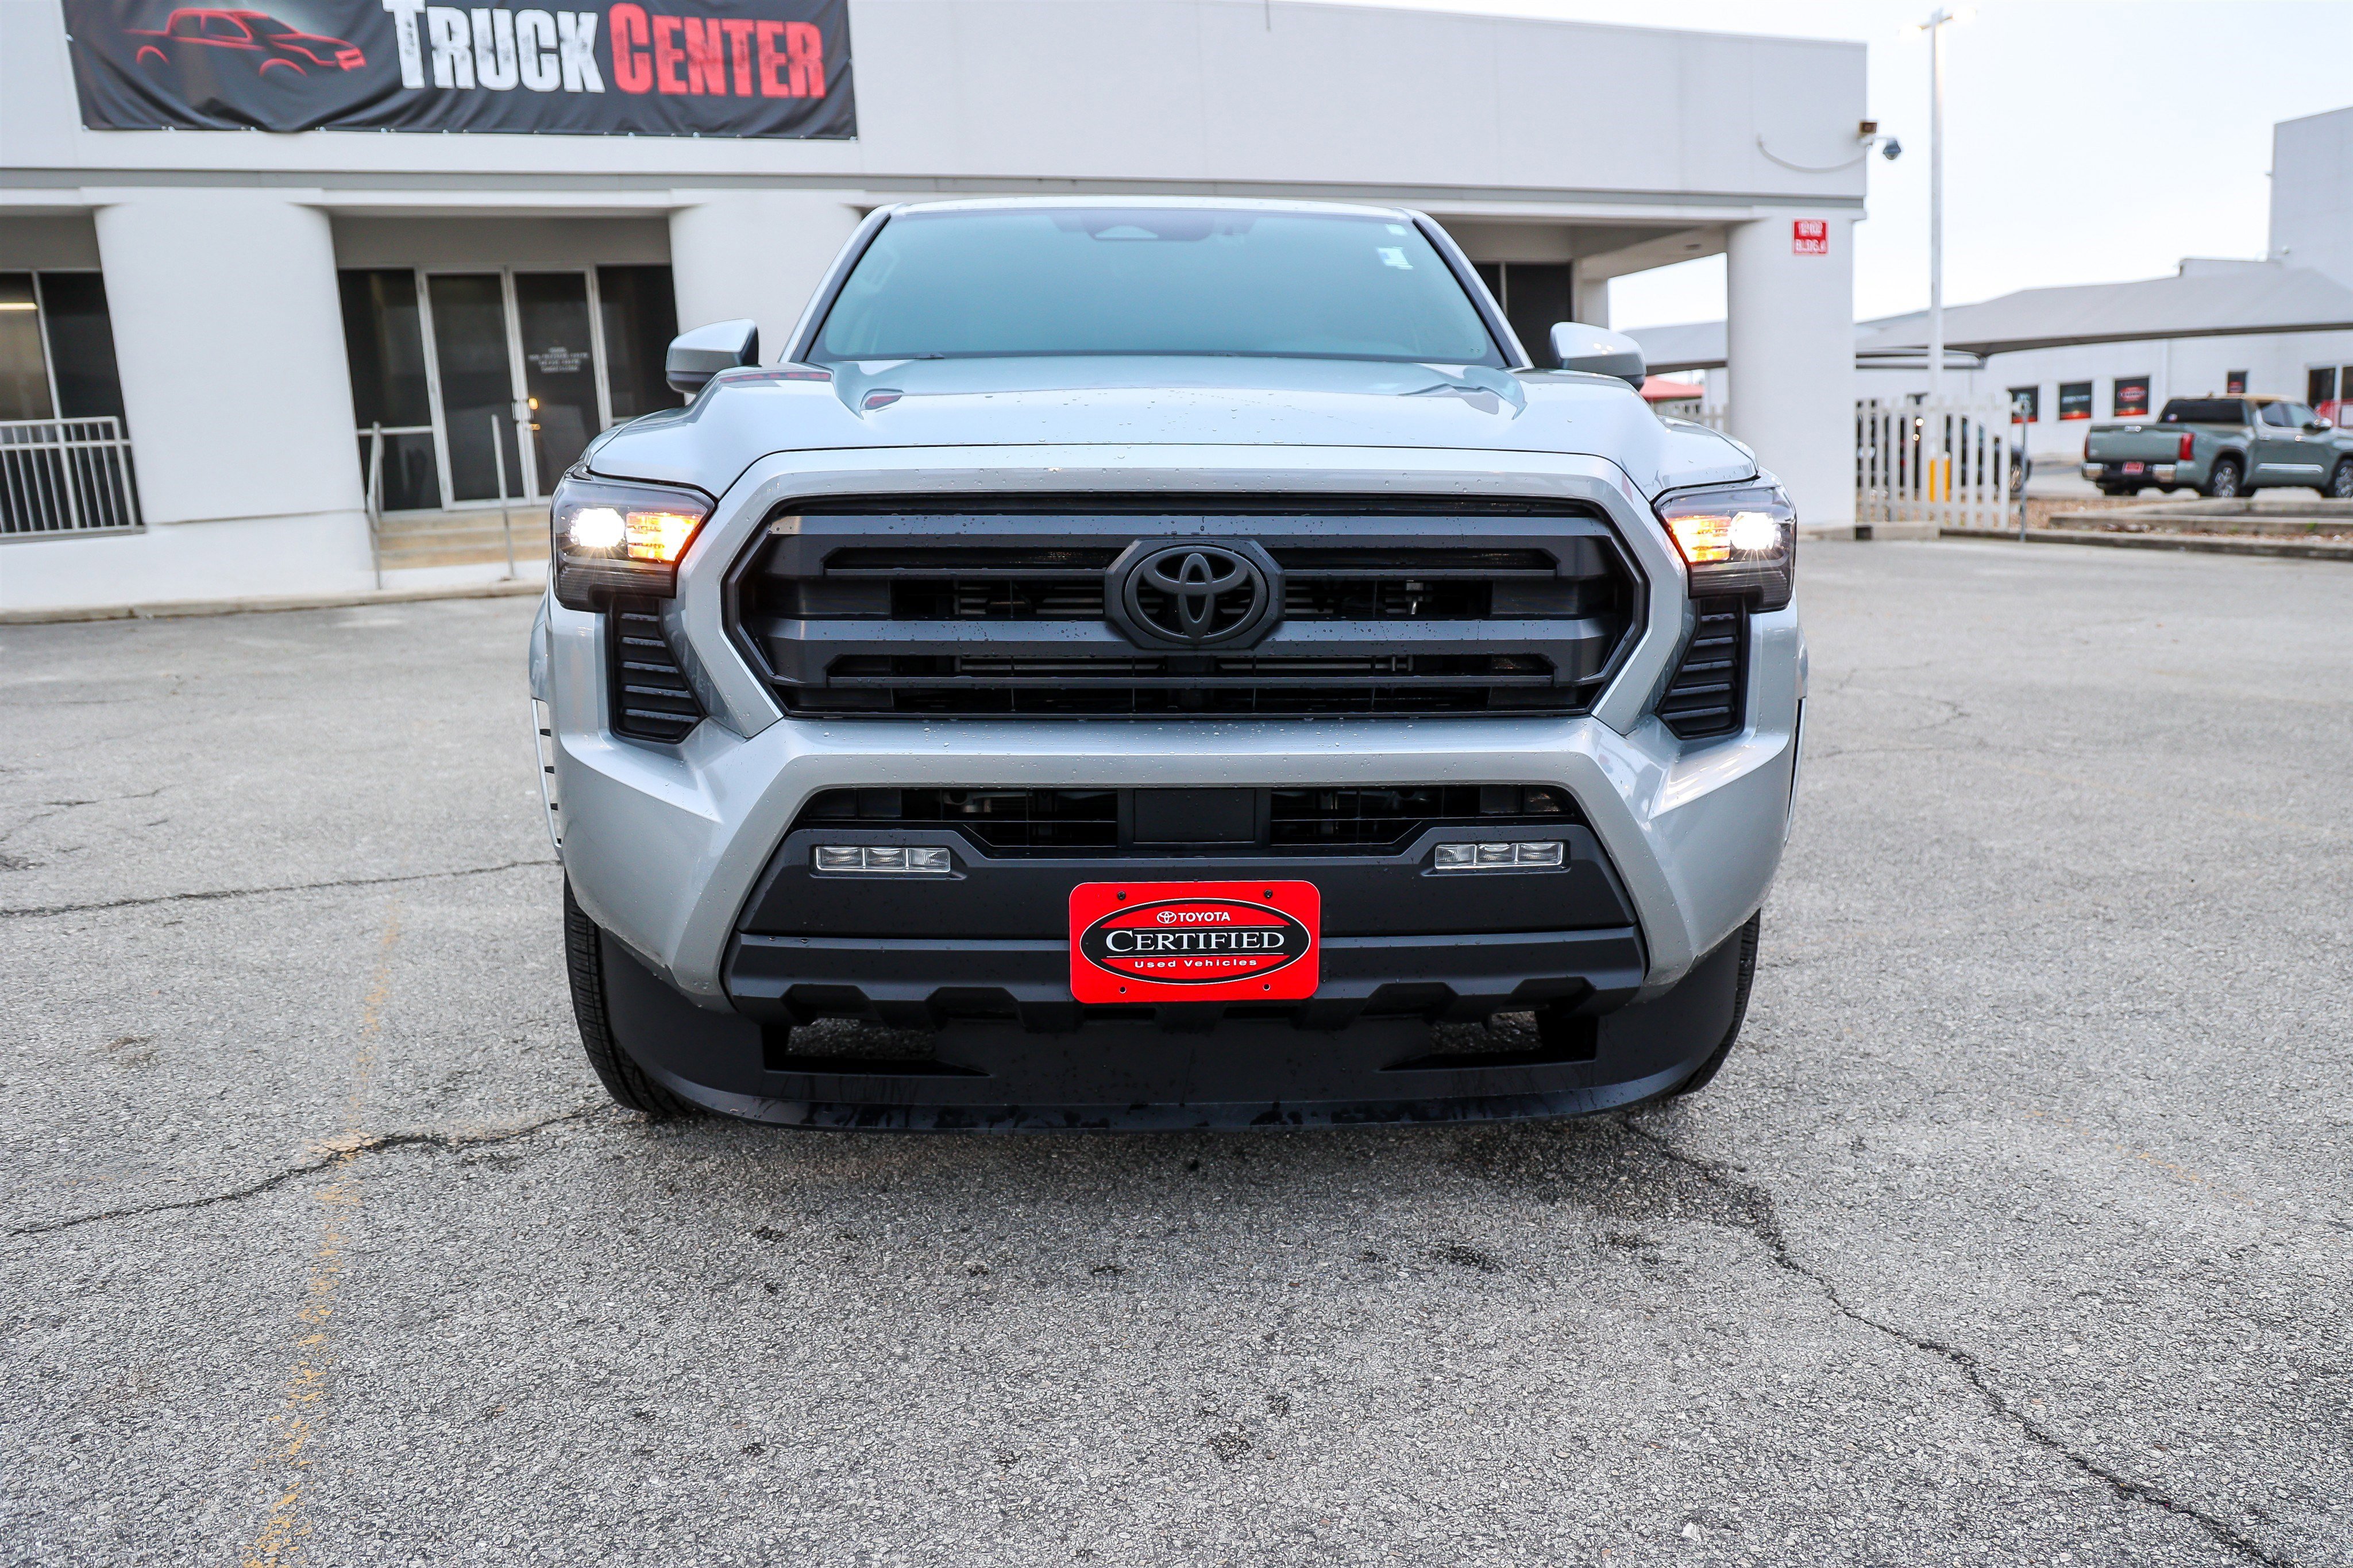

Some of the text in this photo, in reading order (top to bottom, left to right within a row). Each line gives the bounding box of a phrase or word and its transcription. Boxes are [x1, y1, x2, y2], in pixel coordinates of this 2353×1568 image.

[381, 0, 827, 99] TRUCK CENTER
[1178, 912, 1230, 922] TOYOTA
[1106, 930, 1284, 952] CERTIFIED
[1134, 959, 1257, 968] Used Vehicles
